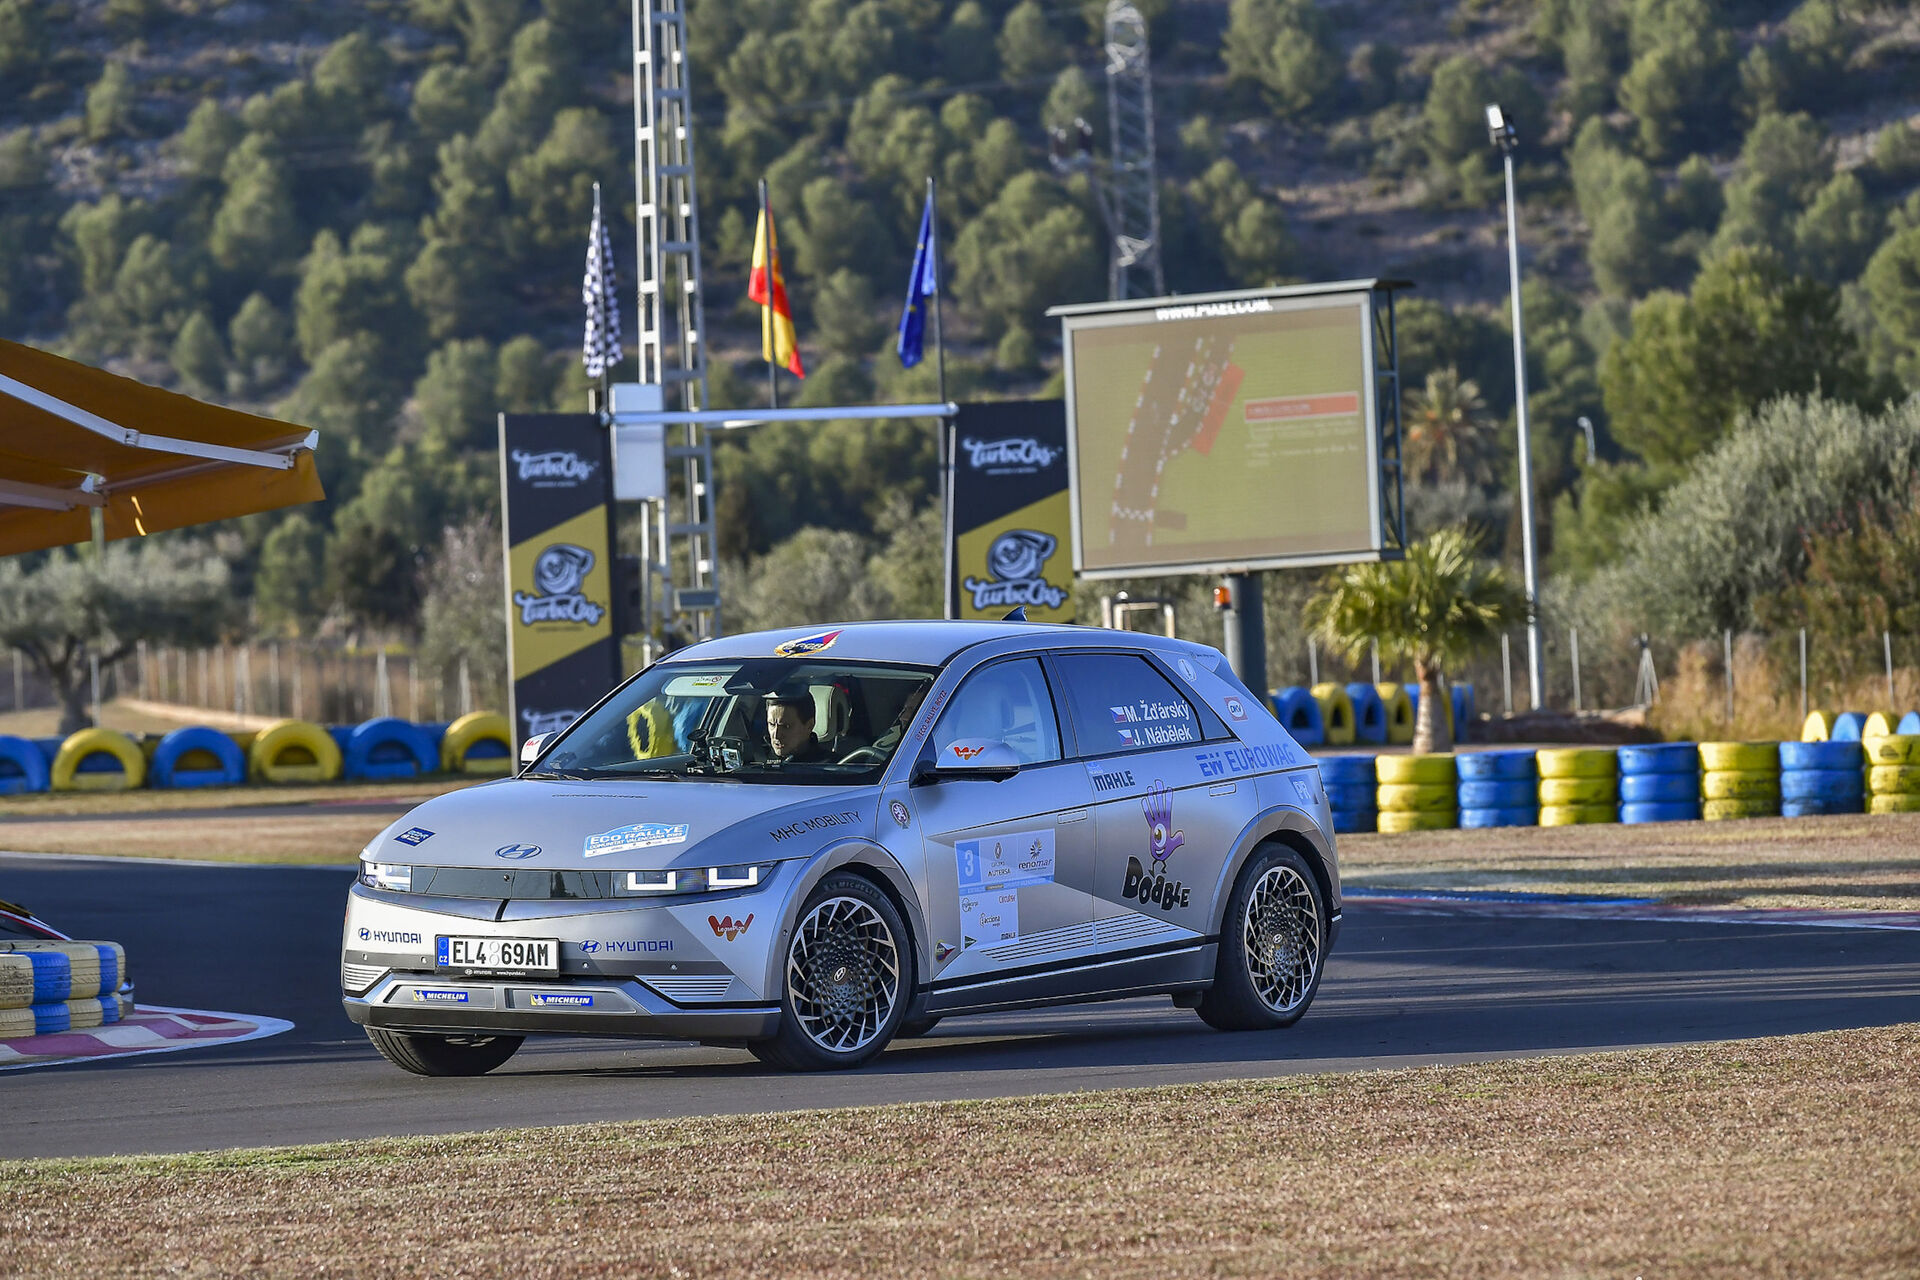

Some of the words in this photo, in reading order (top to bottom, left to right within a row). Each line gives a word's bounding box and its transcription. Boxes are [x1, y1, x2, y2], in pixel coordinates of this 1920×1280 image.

[1123, 705, 1142, 722] M.
[1140, 699, 1189, 721] Žďárský
[1134, 728, 1145, 746] J.
[1144, 724, 1193, 745] Nábělek
[1224, 743, 1296, 772] EUROWAG
[1093, 770, 1135, 792] MAHLE
[590, 835, 621, 845] ECO
[625, 826, 684, 839] RALLYE
[769, 823, 806, 843] MHC
[803, 811, 863, 831] MOBILITY
[964, 849, 974, 877] 3
[1018, 858, 1053, 870] renomar
[374, 931, 422, 944] HYUNDAI
[606, 940, 674, 952] HYUNDAI
[453, 941, 487, 964] EL4
[501, 942, 549, 966] 69AM
[426, 991, 466, 1000] MICHELIN
[545, 996, 591, 1005] MICHELIN
